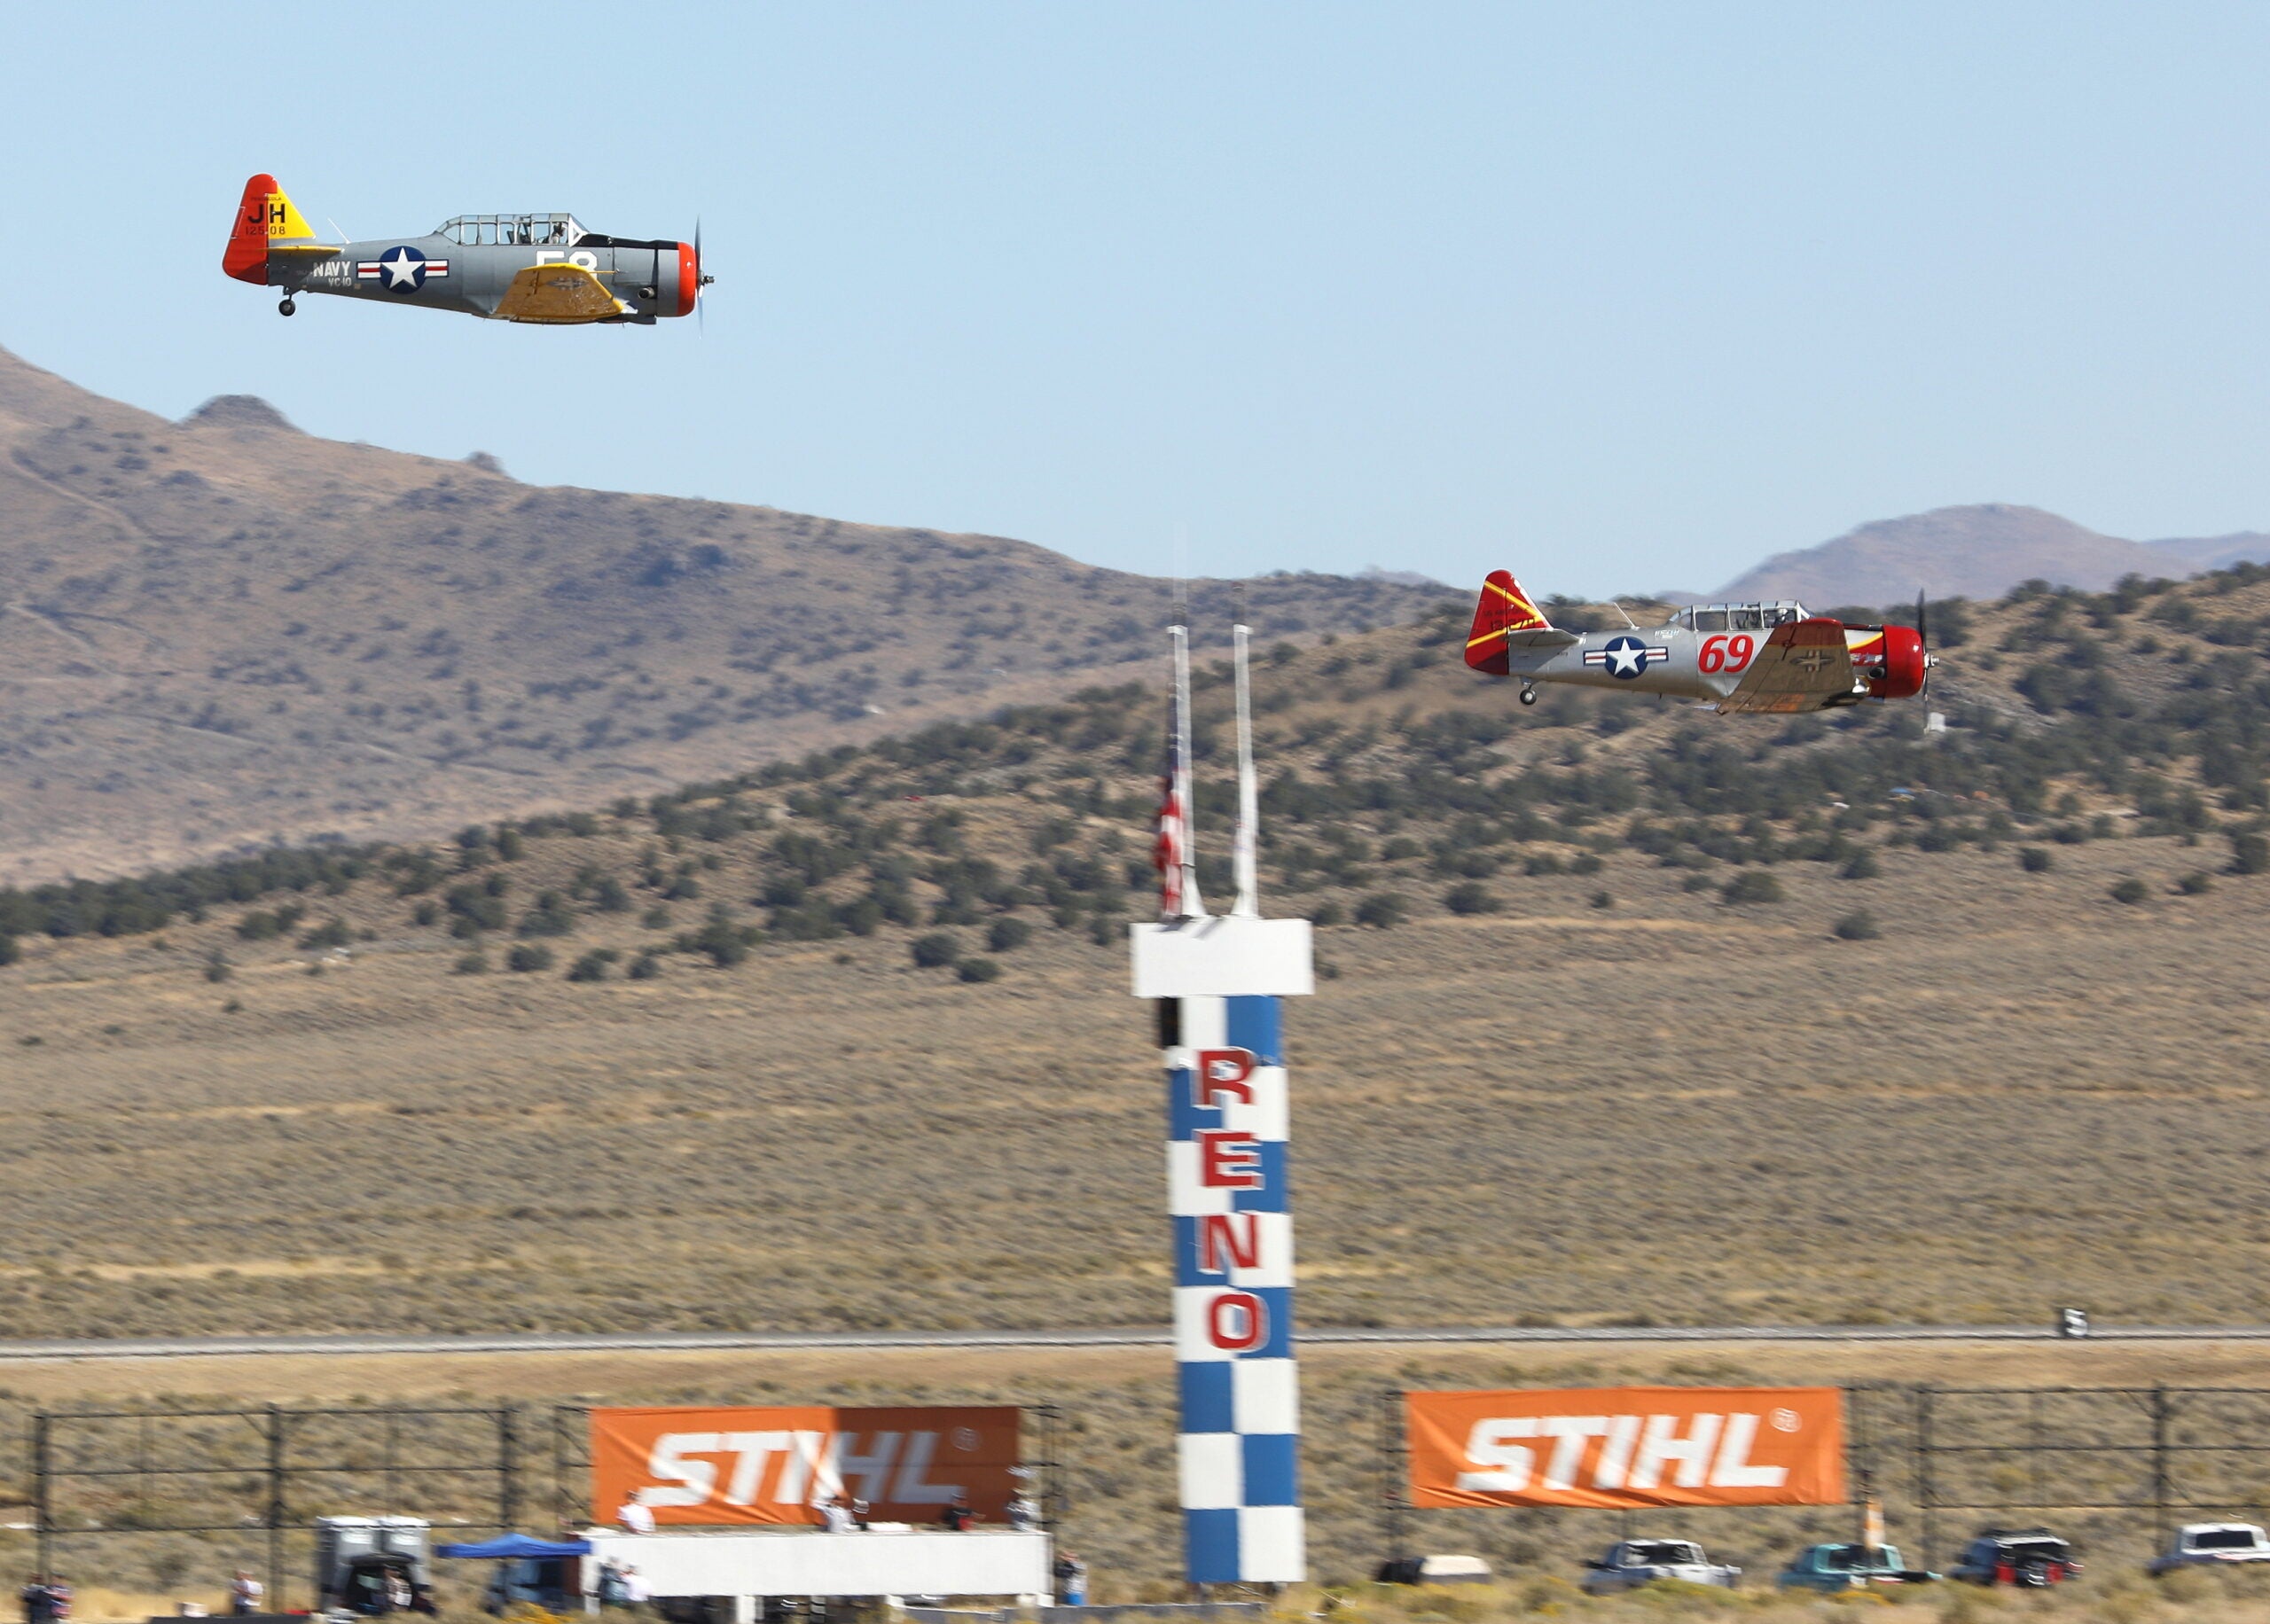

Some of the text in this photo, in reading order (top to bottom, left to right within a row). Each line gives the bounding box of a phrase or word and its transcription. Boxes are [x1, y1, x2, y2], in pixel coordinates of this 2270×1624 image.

[247, 203, 286, 223] JH
[313, 261, 351, 277] NAVY
[1698, 634, 1755, 674] 69
[1194, 1048, 1266, 1350] RENO
[637, 1431, 967, 1506] STIHL
[1454, 1413, 1789, 1492] STIHL
